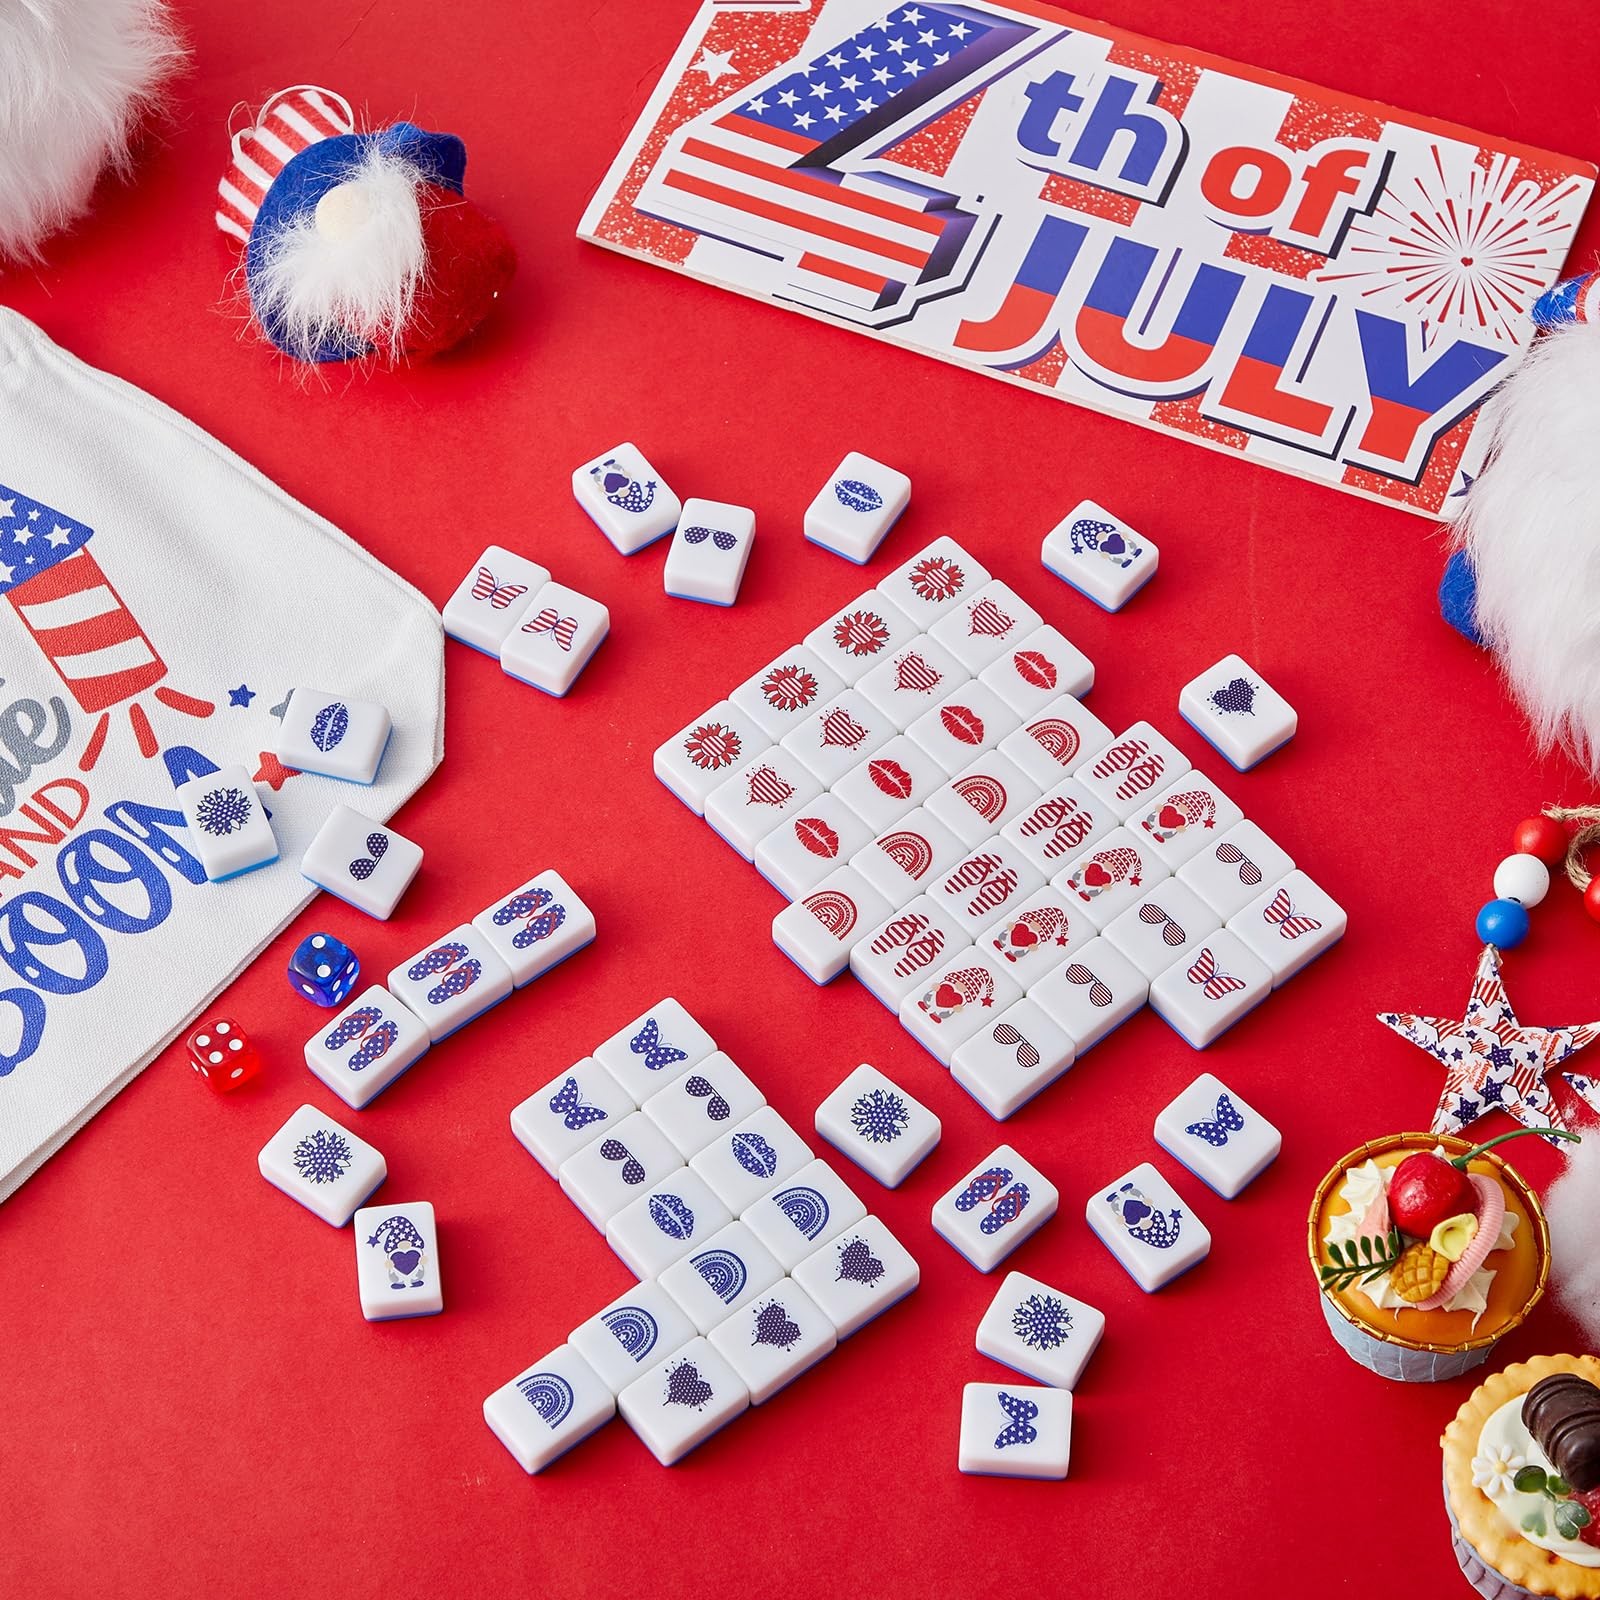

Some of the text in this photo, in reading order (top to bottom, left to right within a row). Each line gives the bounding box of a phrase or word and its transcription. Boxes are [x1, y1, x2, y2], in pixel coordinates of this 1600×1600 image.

[636, 3, 1371, 312] 4th of
[953, 214, 1510, 464] JULY
